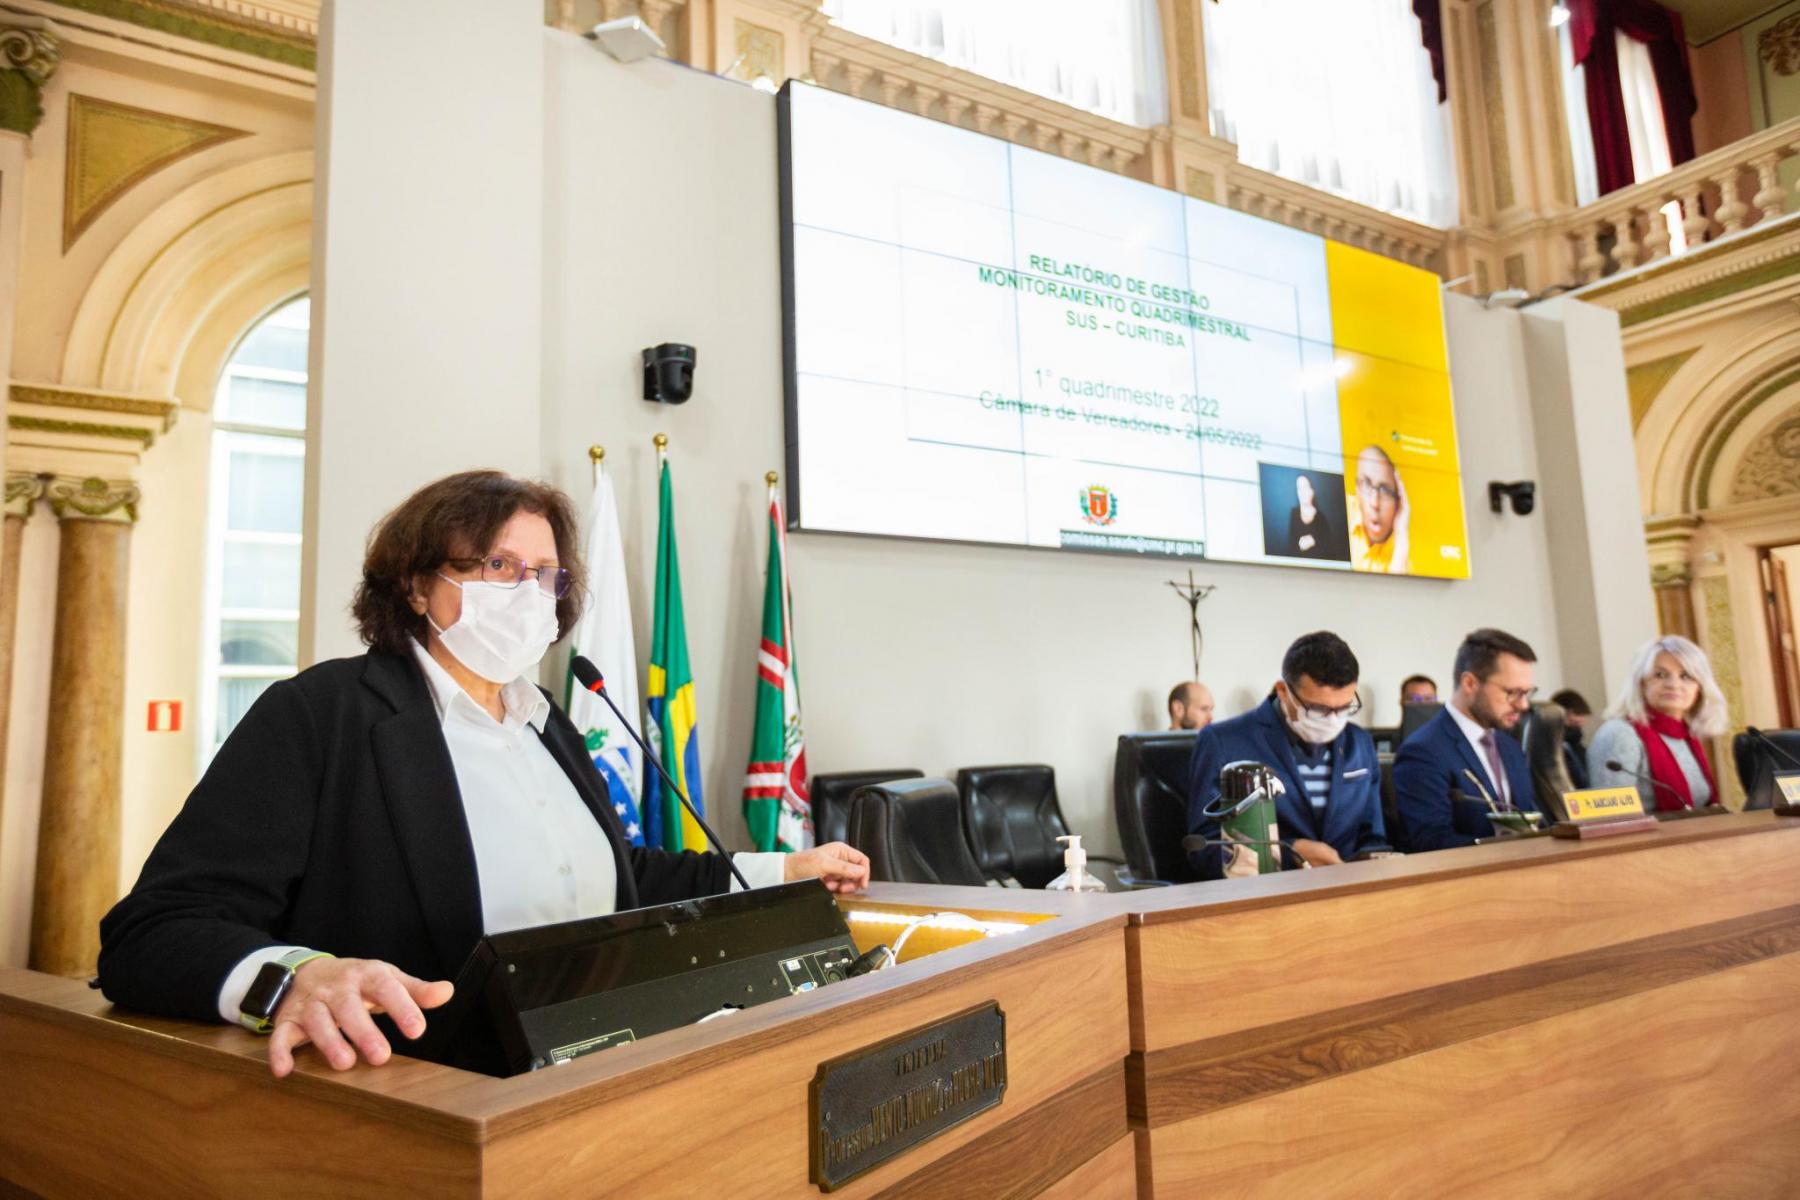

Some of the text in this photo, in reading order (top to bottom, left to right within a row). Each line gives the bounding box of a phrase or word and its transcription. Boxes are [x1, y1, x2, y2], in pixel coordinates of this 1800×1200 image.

[978, 265, 1251, 342] MONITORAMENTO QUADRIMESTRAL
[1029, 253, 1211, 310] RELATÓRIO DE GESTÃO
[1065, 310, 1098, 331] SUS
[1115, 320, 1186, 348] CURITIBA
[978, 389, 1051, 418] Câmara
[1055, 402, 1077, 422] de
[1081, 406, 1172, 436] Vereadores
[1059, 374, 1176, 411] quadrimestre
[1180, 393, 1220, 419] 2022
